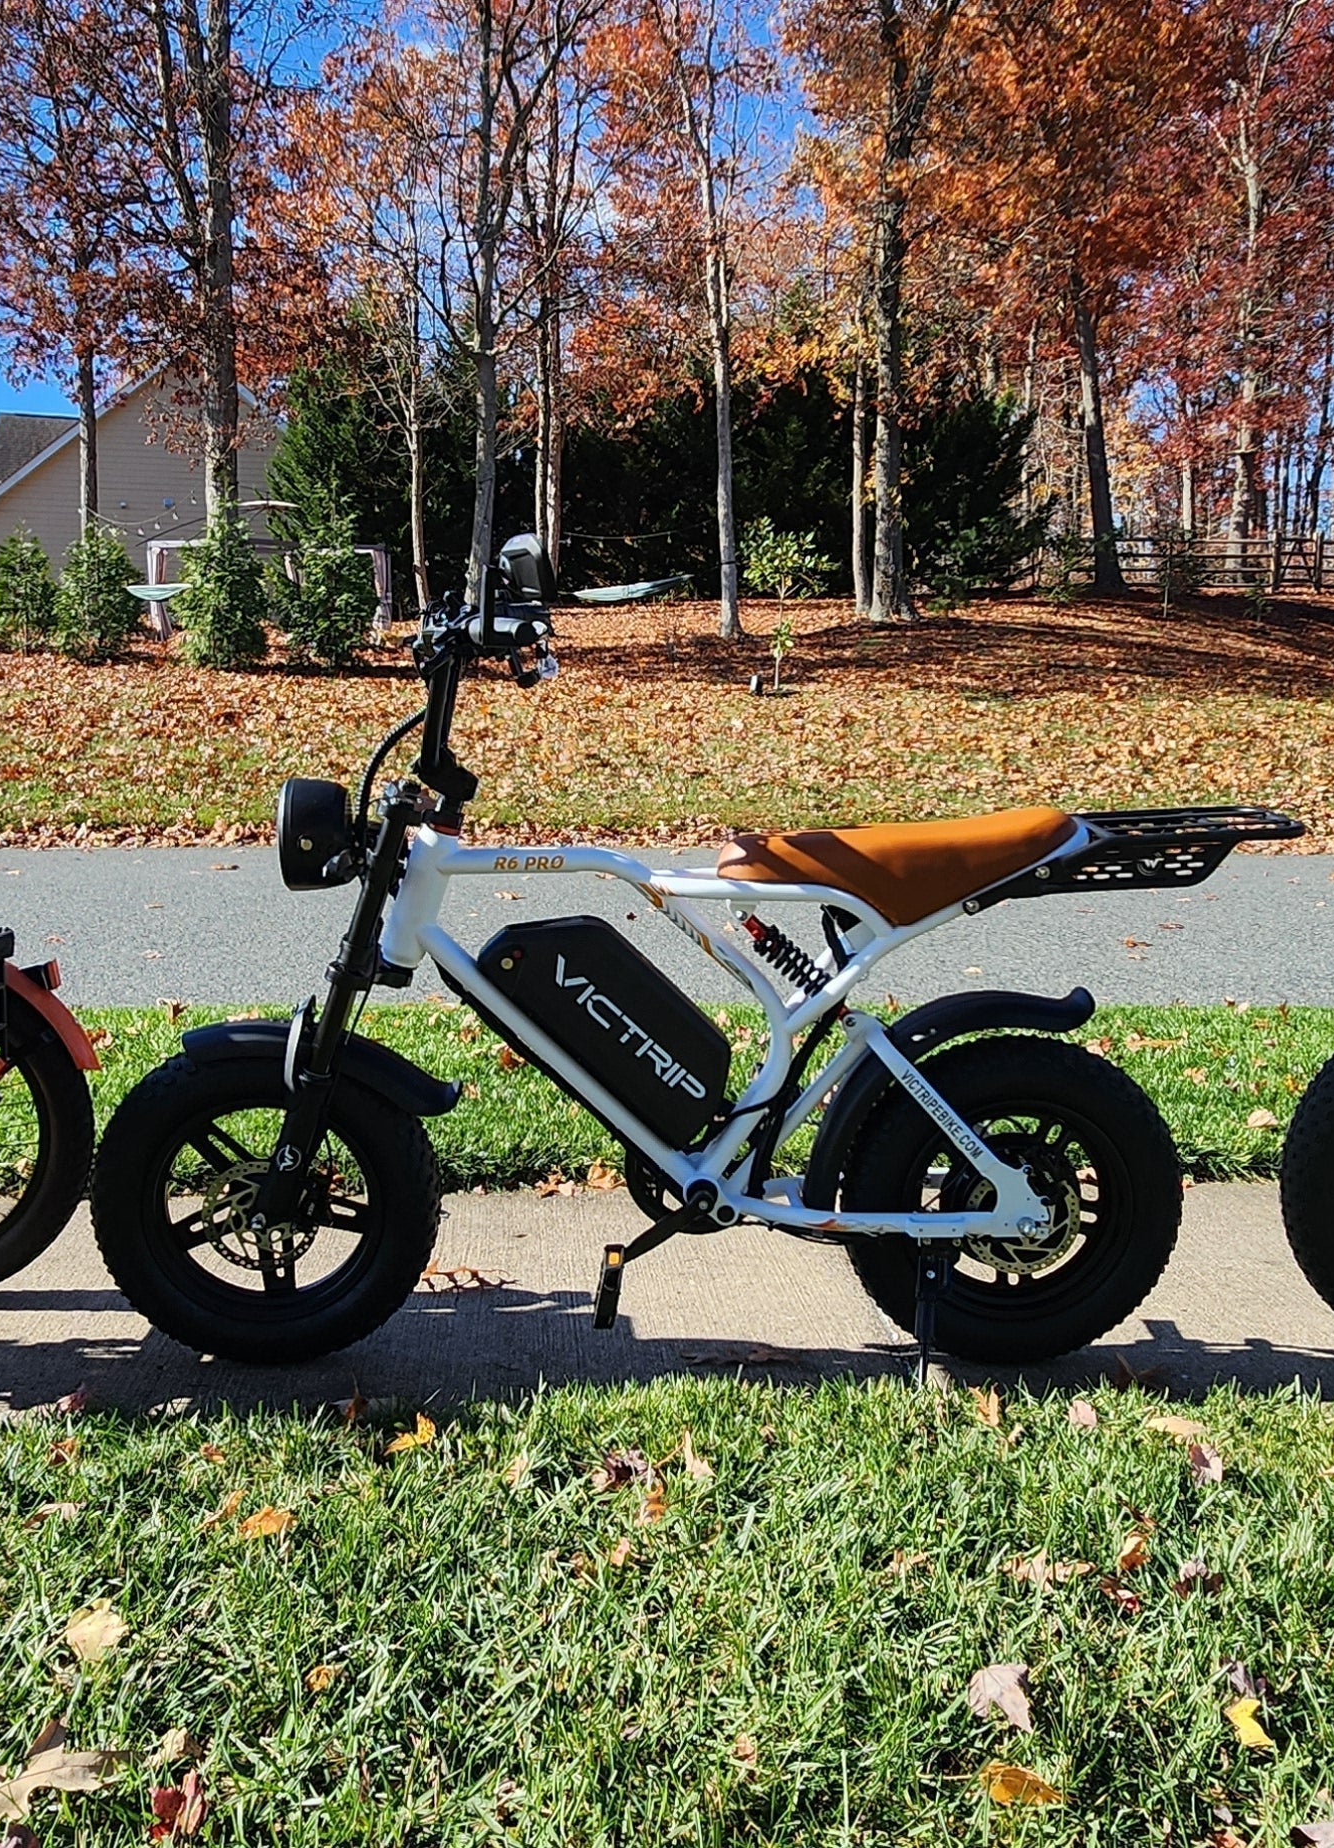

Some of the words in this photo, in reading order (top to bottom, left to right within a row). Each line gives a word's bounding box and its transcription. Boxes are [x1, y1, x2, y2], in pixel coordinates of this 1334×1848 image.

[493, 855, 518, 870] R6
[555, 953, 707, 1099] VICTRIP
[901, 1070, 984, 1160] VICTRIPEBIKE.COM
